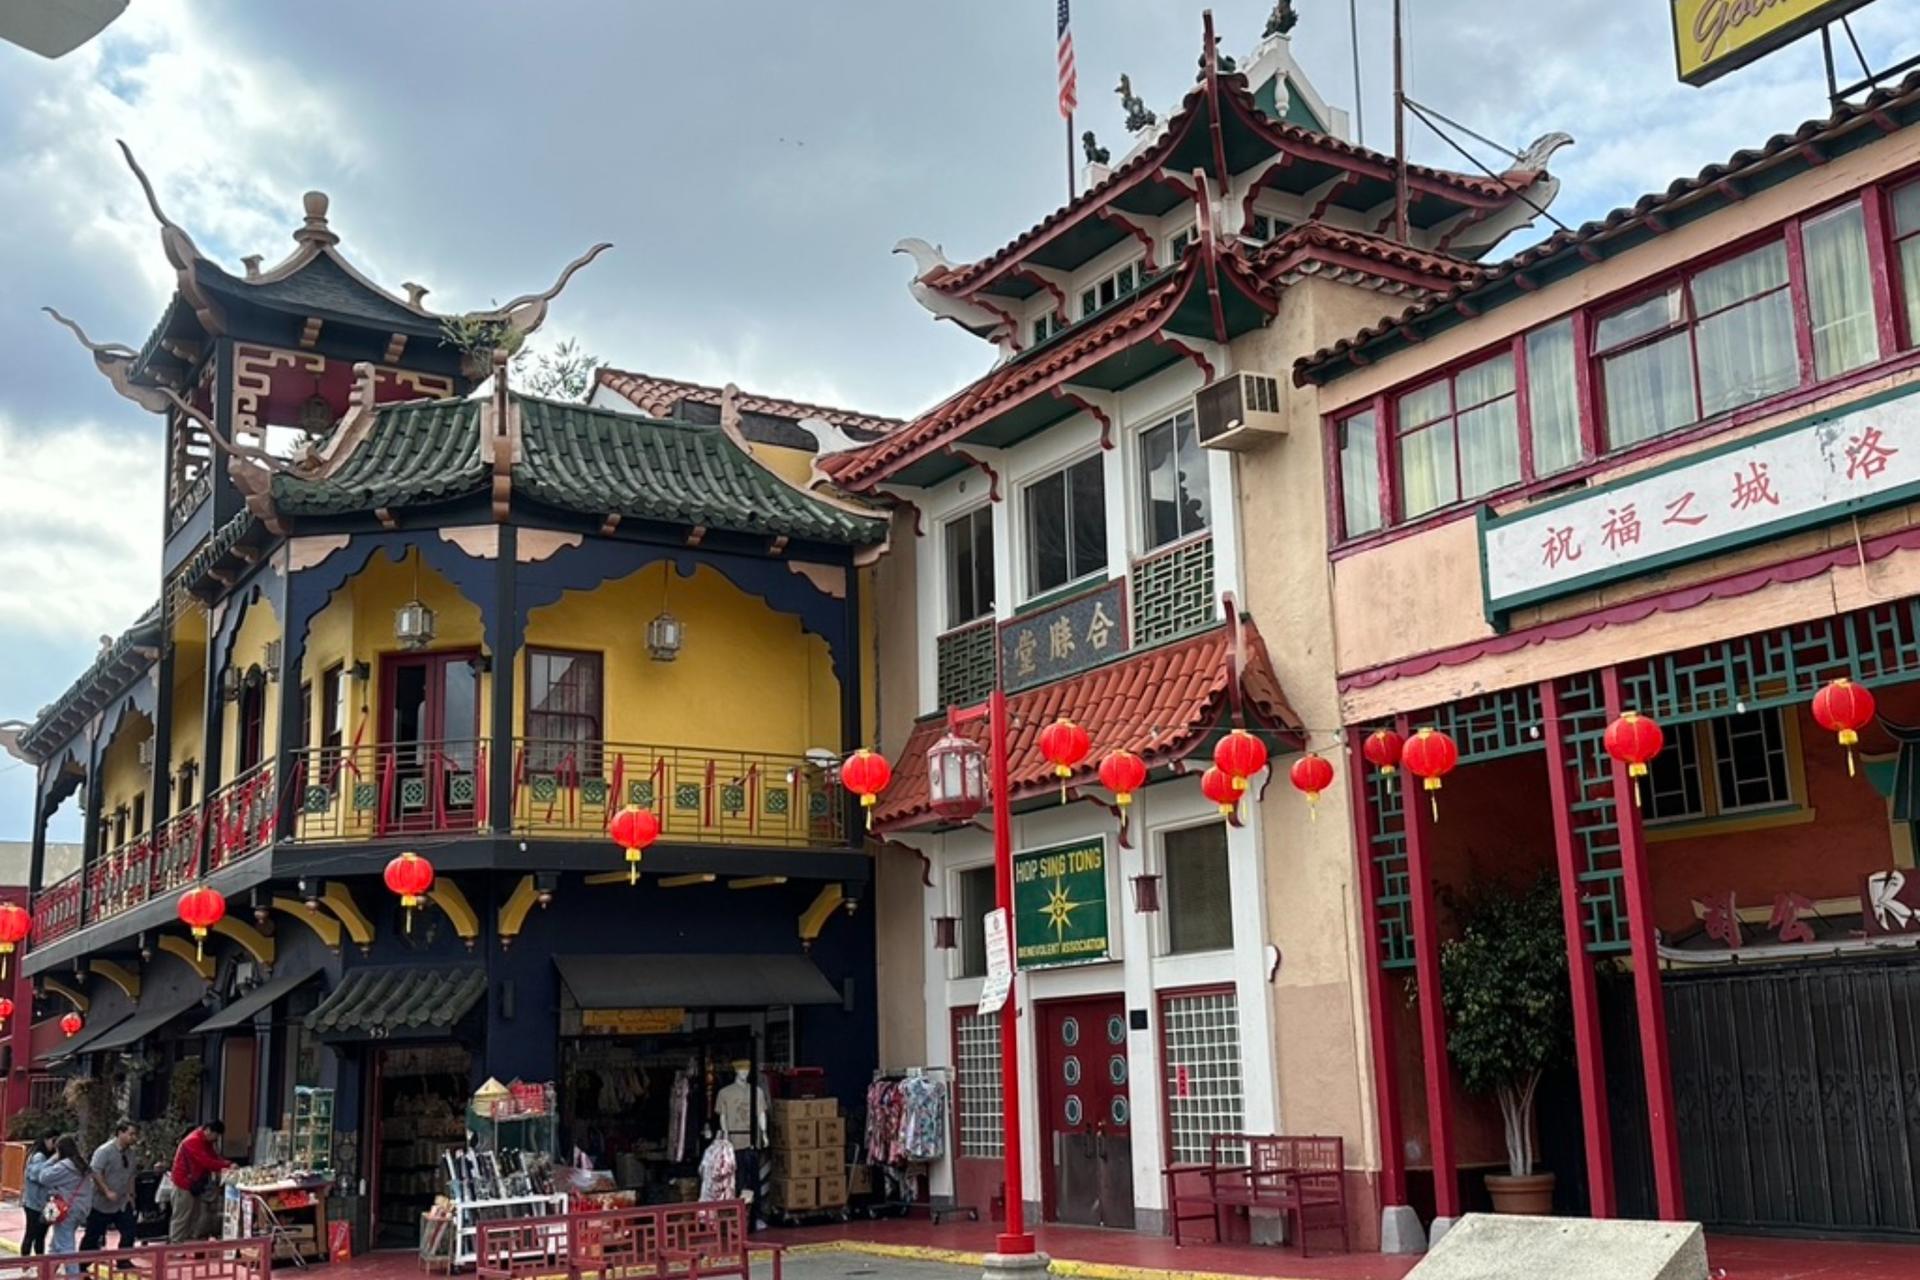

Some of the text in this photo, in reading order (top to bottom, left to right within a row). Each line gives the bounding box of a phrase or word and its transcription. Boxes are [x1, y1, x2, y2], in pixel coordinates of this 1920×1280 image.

[1016, 846, 1102, 883] HOP SING TONG
[1061, 936, 1106, 954] ASSOCIATION
